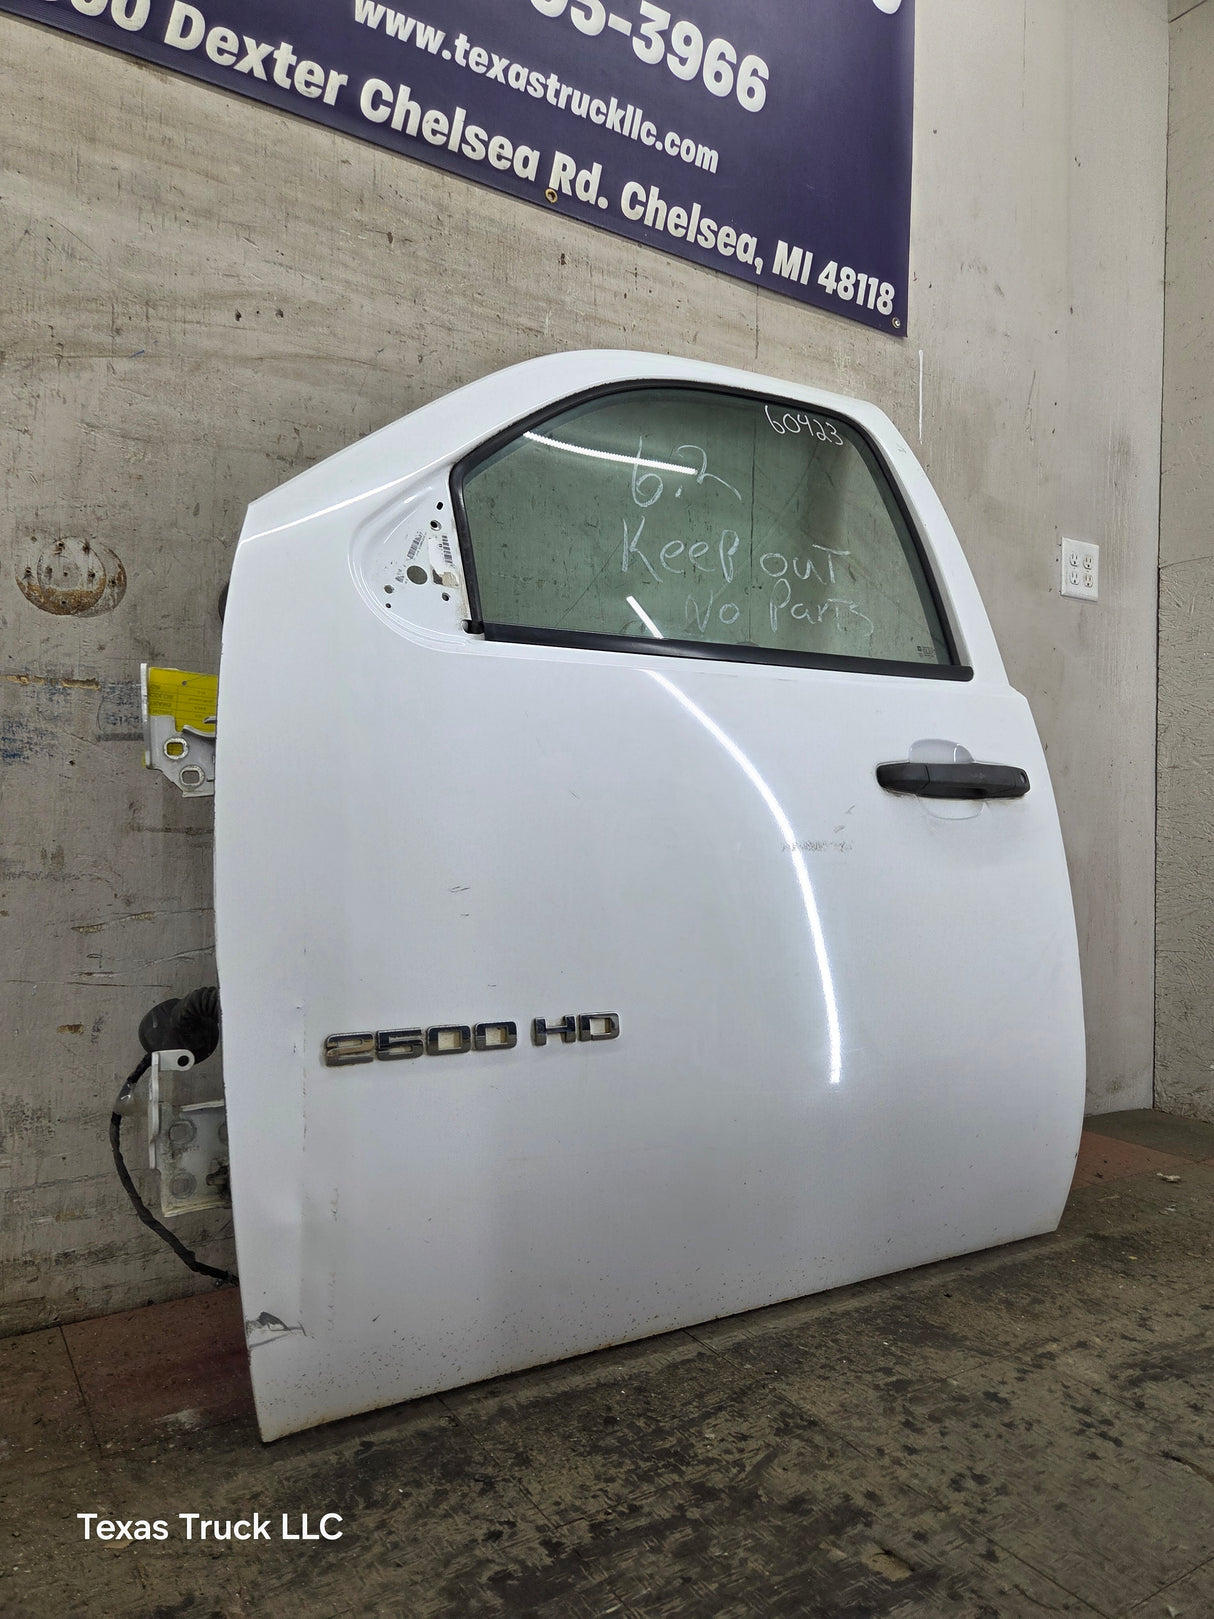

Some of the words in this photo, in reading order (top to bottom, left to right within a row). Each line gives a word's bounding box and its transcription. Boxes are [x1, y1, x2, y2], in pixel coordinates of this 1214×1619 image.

[354, 0, 719, 174] www.texastruckllc.com
[163, 0, 349, 106] Dexter
[359, 77, 541, 182] Chelsea
[548, 150, 609, 210] Rd.
[620, 180, 764, 275] Chelsea,
[771, 239, 814, 286] MI
[817, 260, 896, 316] 48118
[685, 589, 741, 633] No
[324, 1020, 518, 1068] 2500
[531, 1010, 621, 1048] HD
